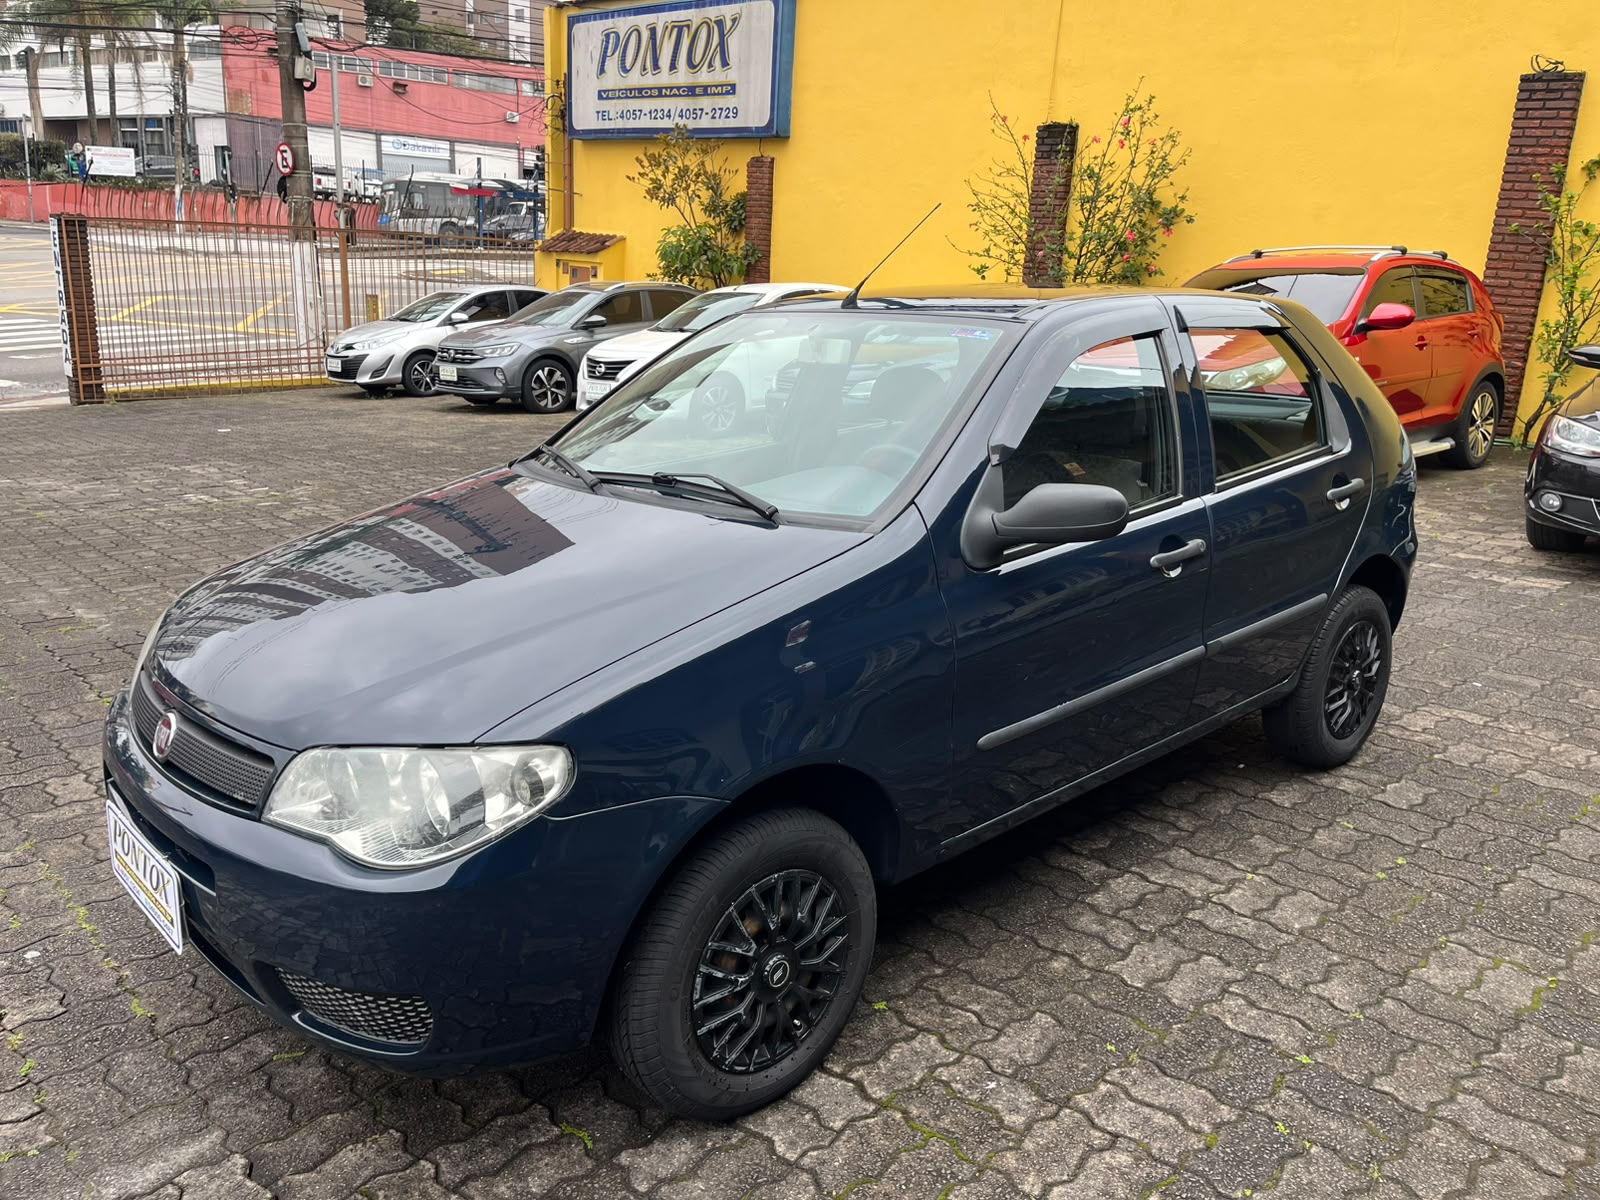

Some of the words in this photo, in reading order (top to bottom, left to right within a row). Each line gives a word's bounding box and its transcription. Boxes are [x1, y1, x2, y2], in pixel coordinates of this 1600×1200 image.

[597, 13, 741, 79] PONTOX
[662, 87, 691, 96] NAC.
[695, 87, 704, 95] E
[707, 86, 733, 94] IMP.
[52, 230, 71, 363] ENTRADA
[112, 818, 170, 905] PONTOX
